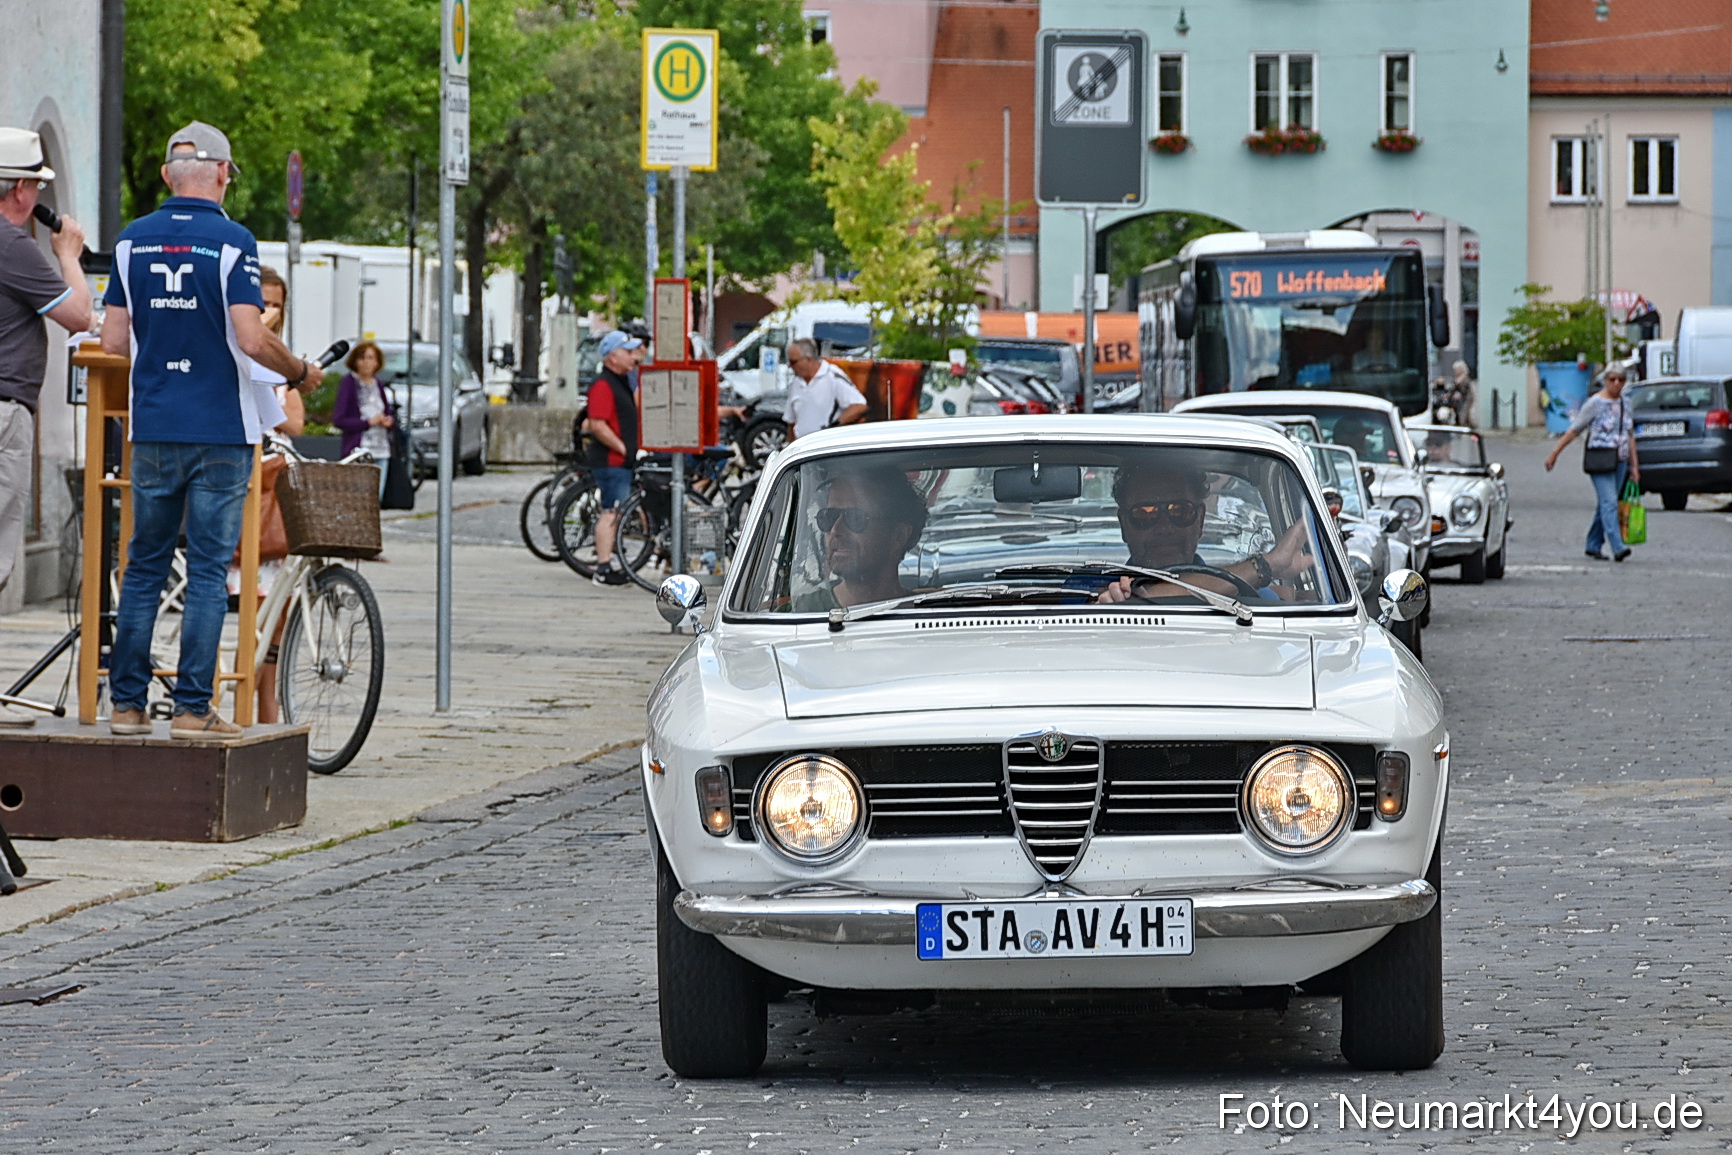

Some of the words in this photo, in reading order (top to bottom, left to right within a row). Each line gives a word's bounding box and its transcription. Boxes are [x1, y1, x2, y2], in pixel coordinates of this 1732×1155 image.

[669, 55, 690, 88] H
[661, 109, 697, 119] Rathaus
[1072, 105, 1112, 120] ZONE
[132, 244, 163, 254] WILLIAMS
[191, 245, 220, 259] RACING
[1230, 270, 1262, 298] 570
[1277, 268, 1386, 293] Woffenbach
[150, 296, 197, 310] randstad
[1167, 906, 1186, 918] 04
[946, 910, 1022, 951] STA
[1052, 908, 1100, 949] AV
[925, 937, 936, 951] D
[1169, 935, 1185, 948] 11
